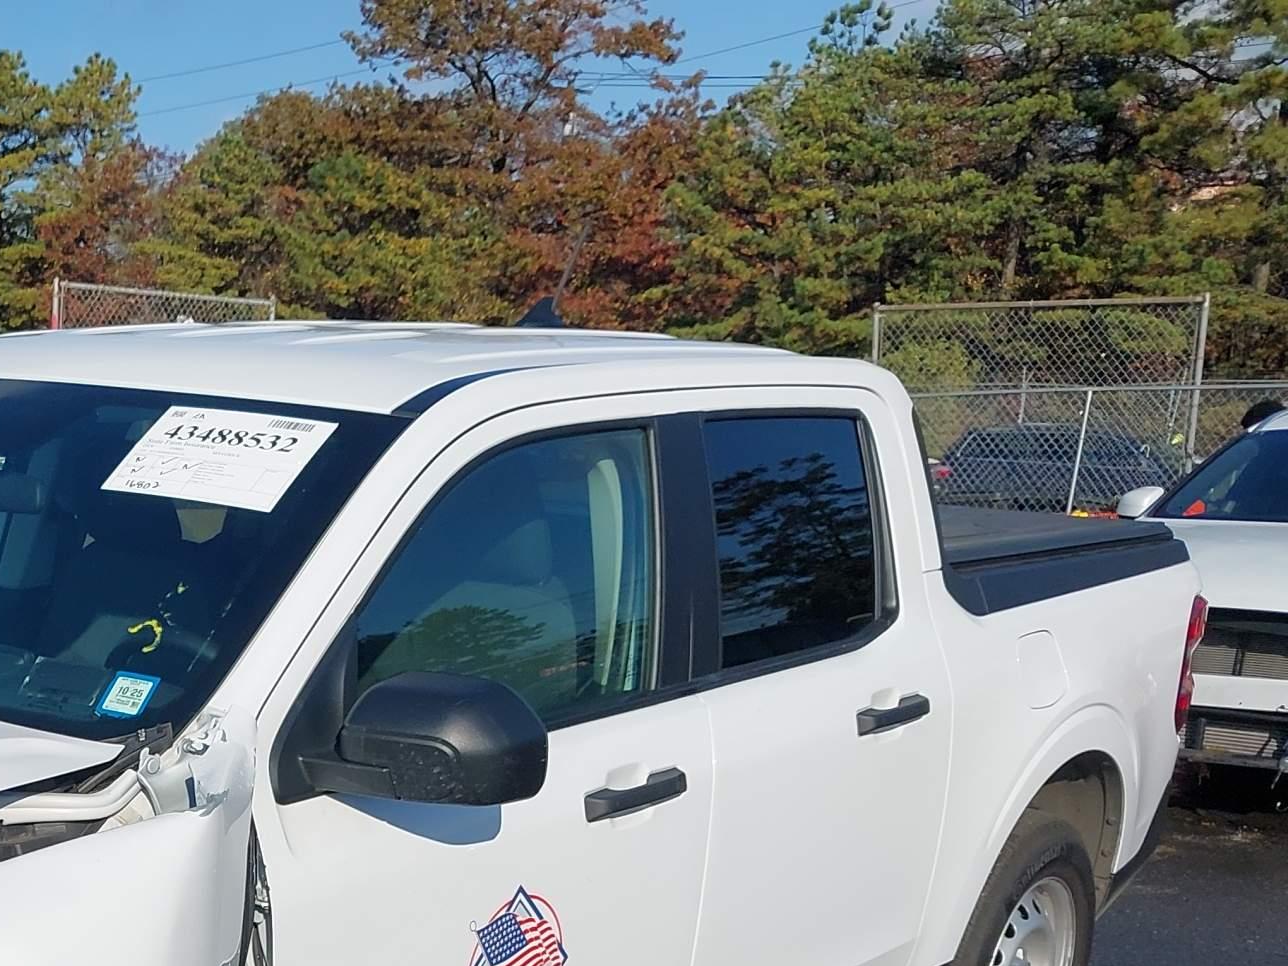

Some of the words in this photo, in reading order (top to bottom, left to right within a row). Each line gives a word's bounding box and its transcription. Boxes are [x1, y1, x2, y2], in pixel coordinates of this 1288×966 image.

[164, 424, 299, 453] 43488532
[117, 686, 129, 696] 10
[130, 688, 144, 698] 25
